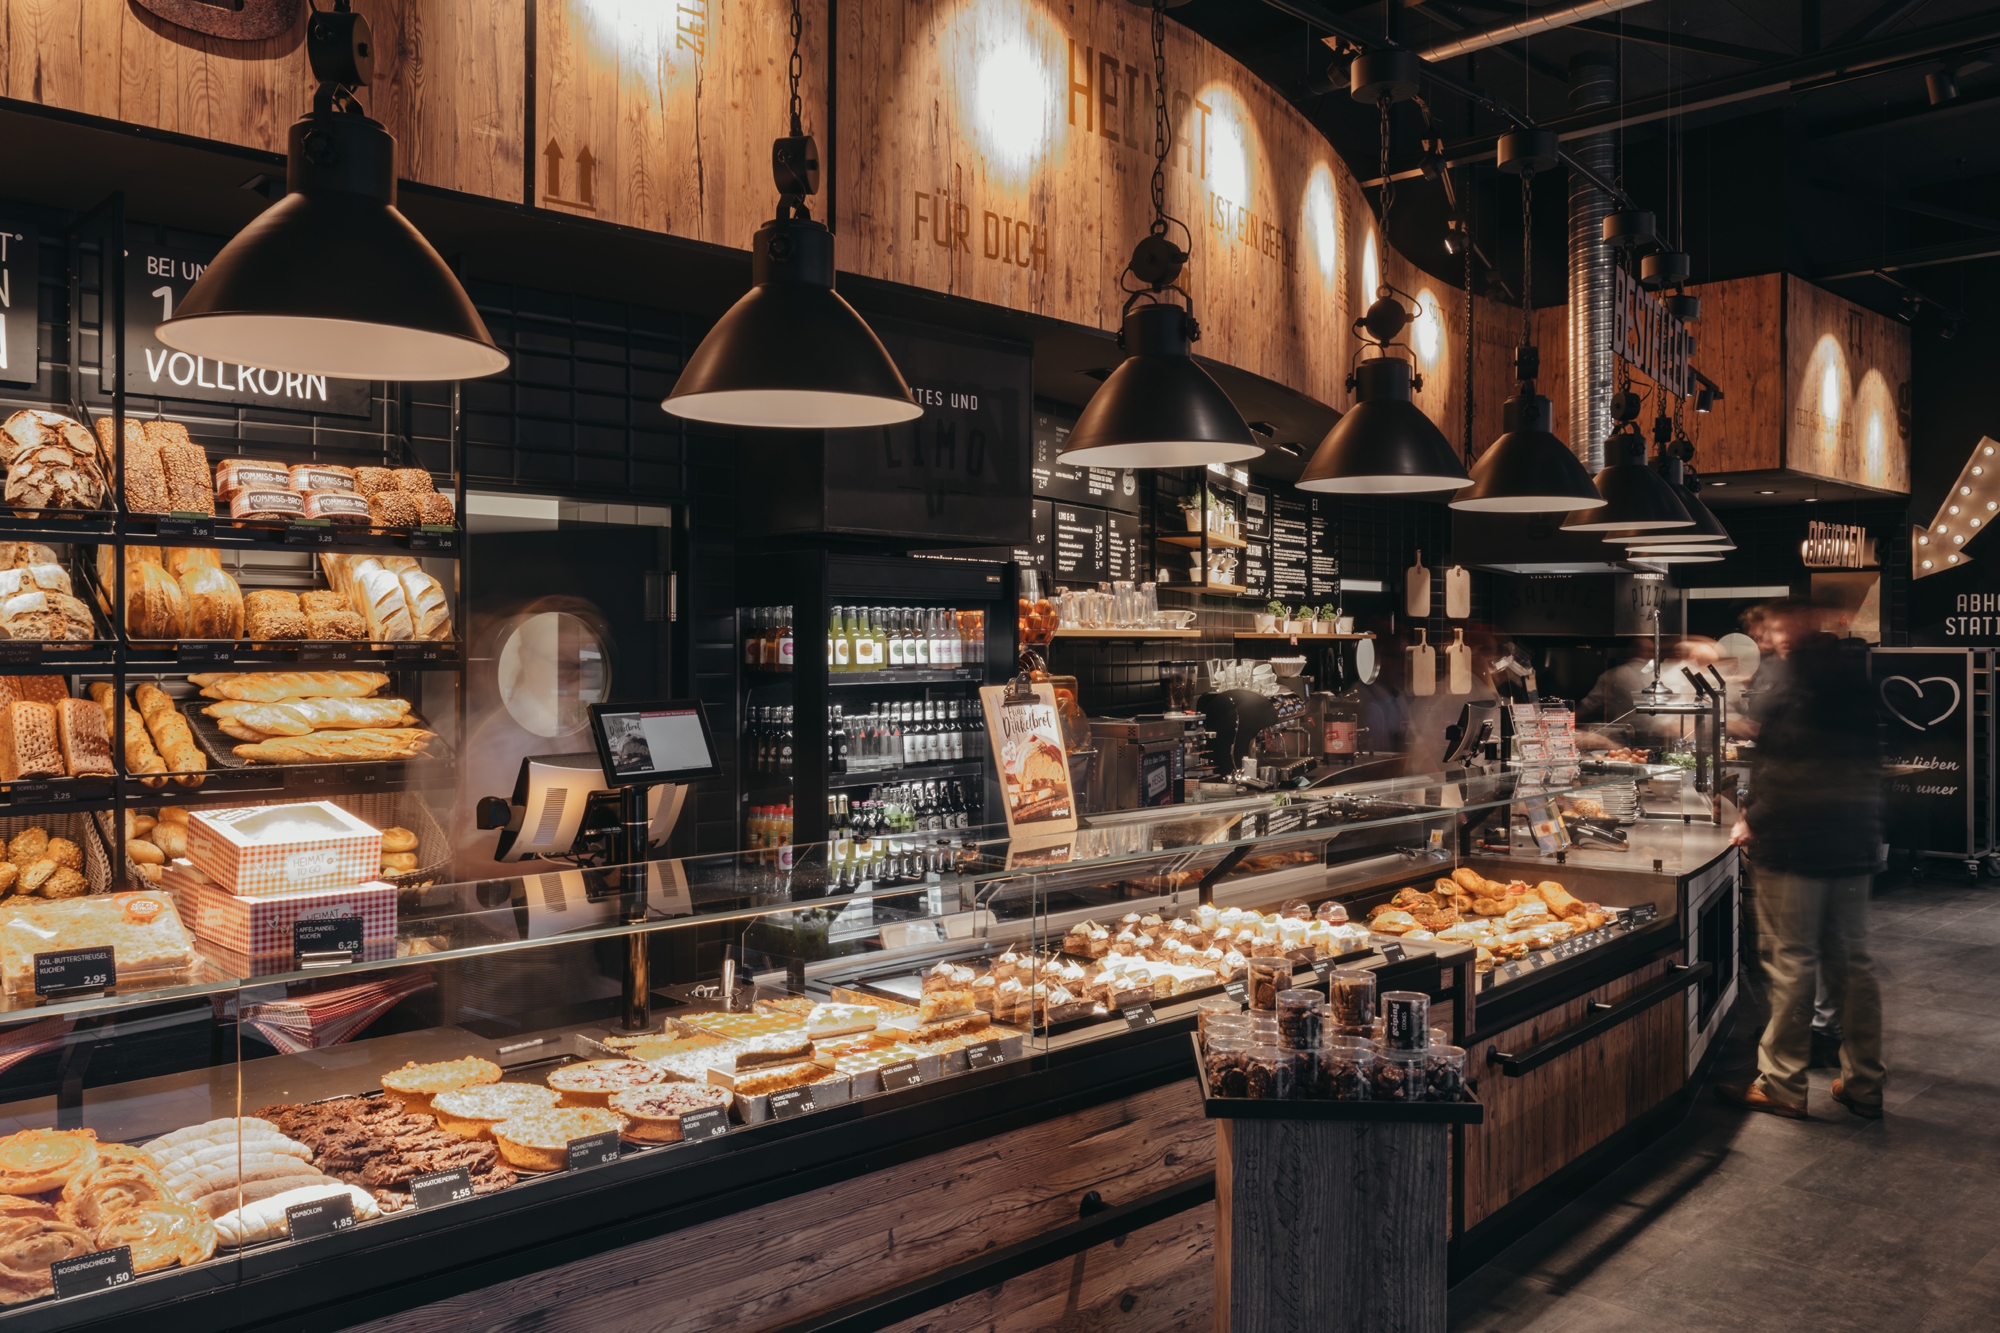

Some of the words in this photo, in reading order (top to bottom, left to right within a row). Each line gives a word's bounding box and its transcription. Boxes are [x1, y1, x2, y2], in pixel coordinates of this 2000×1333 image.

[1209, 190, 1232, 235] IST
[1238, 205, 1258, 250] EIN
[913, 188, 972, 255] FÜR
[983, 210, 1048, 274] DICH
[147, 256, 175, 278] BEI
[145, 348, 327, 401] VOLLKORN
[951, 392, 978, 411] UND
[192, 528, 208, 536] 3,95
[318, 535, 332, 543] 3,25
[1631, 585, 1667, 611] PIZZA
[1001, 708, 1052, 740] Dinkelbrot
[1912, 755, 1960, 771] lieben
[53, 792, 71, 800] 3,25
[293, 853, 325, 868] HEIMAT
[297, 866, 307, 877] TO
[308, 864, 322, 876] GO
[298, 924, 338, 933] APFELMANDEL-
[300, 932, 321, 940] KUCHEN
[338, 940, 359, 950] 6,25
[39, 952, 111, 966] XXL-BUTTERSTREUSEL-
[39, 965, 65, 975] KUCHEN
[83, 974, 107, 985] 2,95
[992, 1054, 1004, 1064] 1,75
[907, 1075, 921, 1085] 1,70
[774, 1099, 789, 1108] KUCHEN
[800, 1102, 815, 1112] 1,75
[684, 1121, 700, 1130] KUCHEN
[711, 1125, 726, 1136] 6,95
[571, 1139, 604, 1152] MOHNSTREUSEL
[572, 1149, 589, 1158] KUCHEN
[601, 1151, 618, 1163] 6,25
[414, 1173, 460, 1189] NOUGATCREMERING
[451, 1187, 471, 1200] 2,55
[291, 1206, 323, 1219] BOMBOLONI
[332, 1216, 353, 1229] 1,85
[57, 1255, 117, 1275] ROSINENSCHNECKE
[105, 1271, 130, 1286] 1,50
